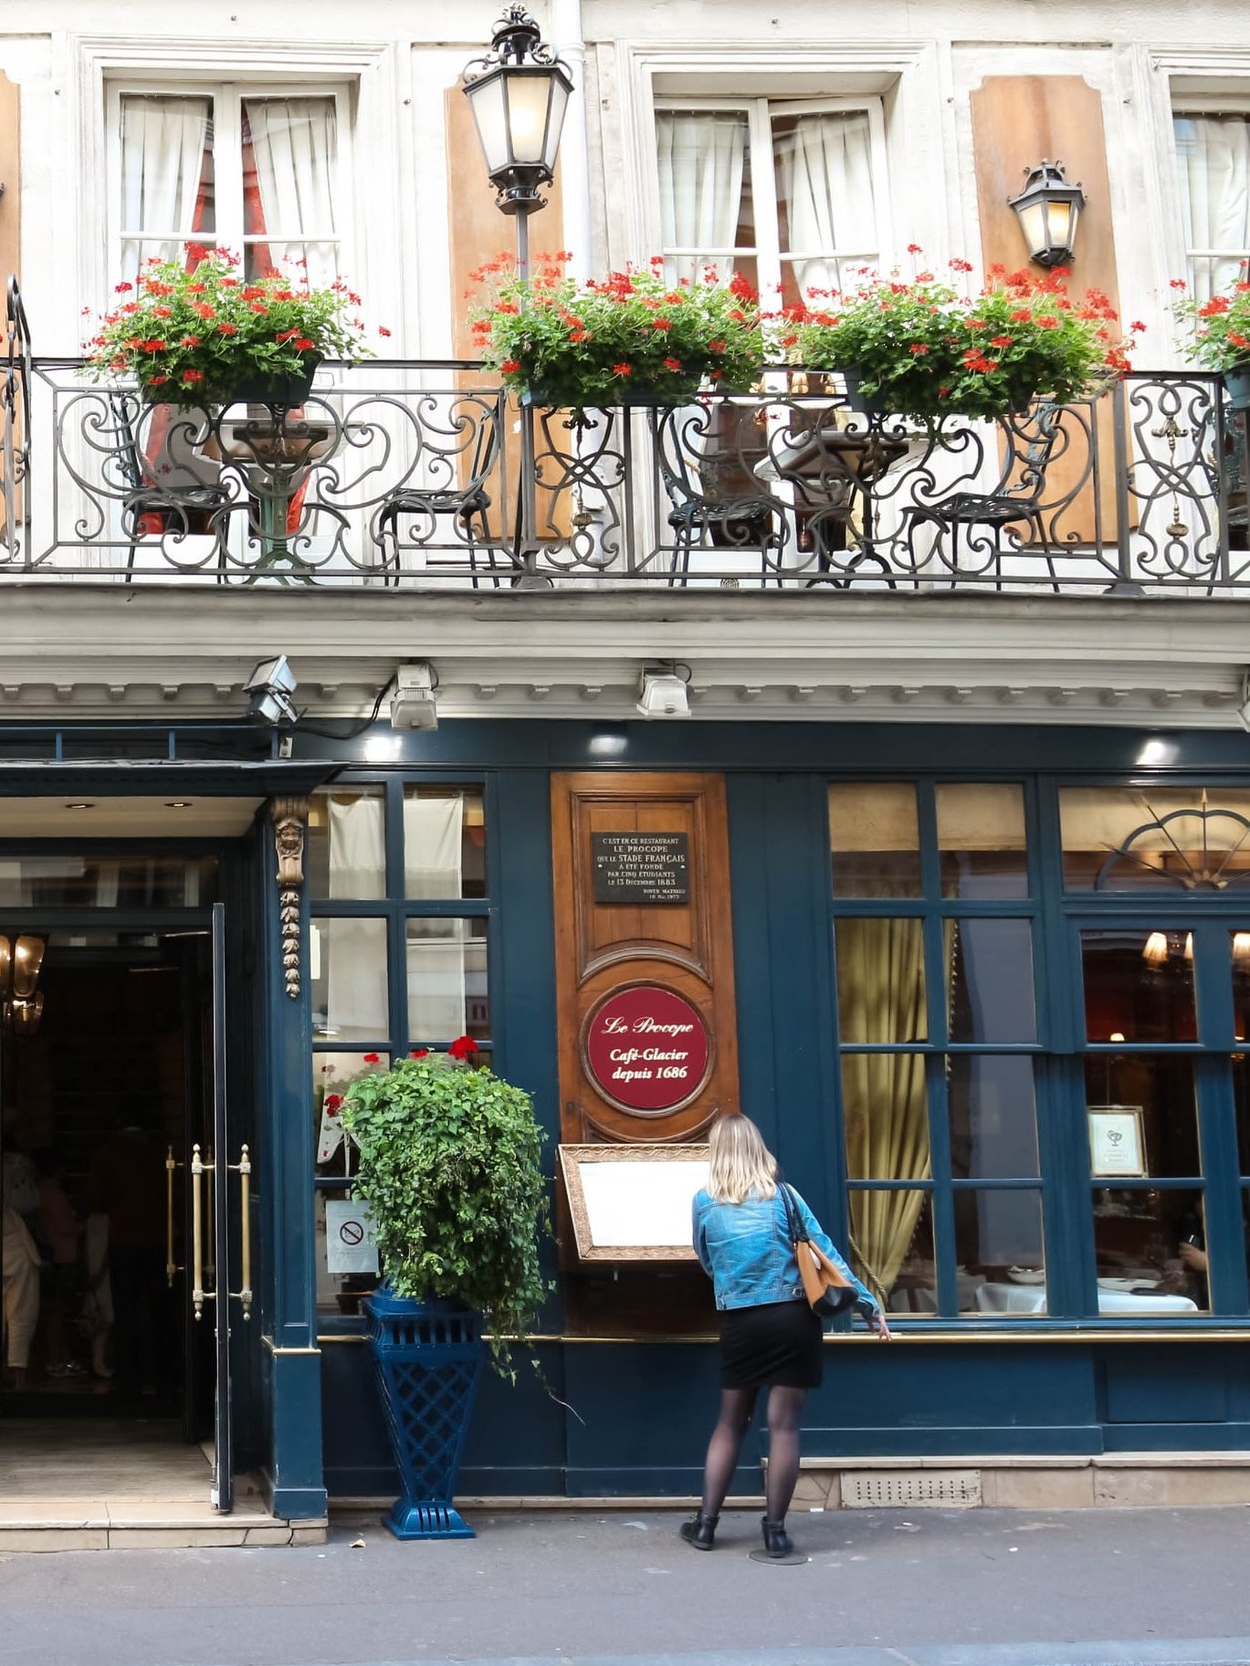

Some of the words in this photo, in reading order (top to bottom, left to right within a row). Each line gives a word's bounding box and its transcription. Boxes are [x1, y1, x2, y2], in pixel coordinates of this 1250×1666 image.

[618, 854, 643, 862] STADE
[645, 854, 685, 864] FRANÇAIS
[601, 1016, 628, 1034] Le
[632, 1016, 694, 1038] Procope
[610, 1048, 688, 1065] Café-Glacier
[612, 1066, 652, 1083] depuis
[655, 1066, 689, 1079] 1686
